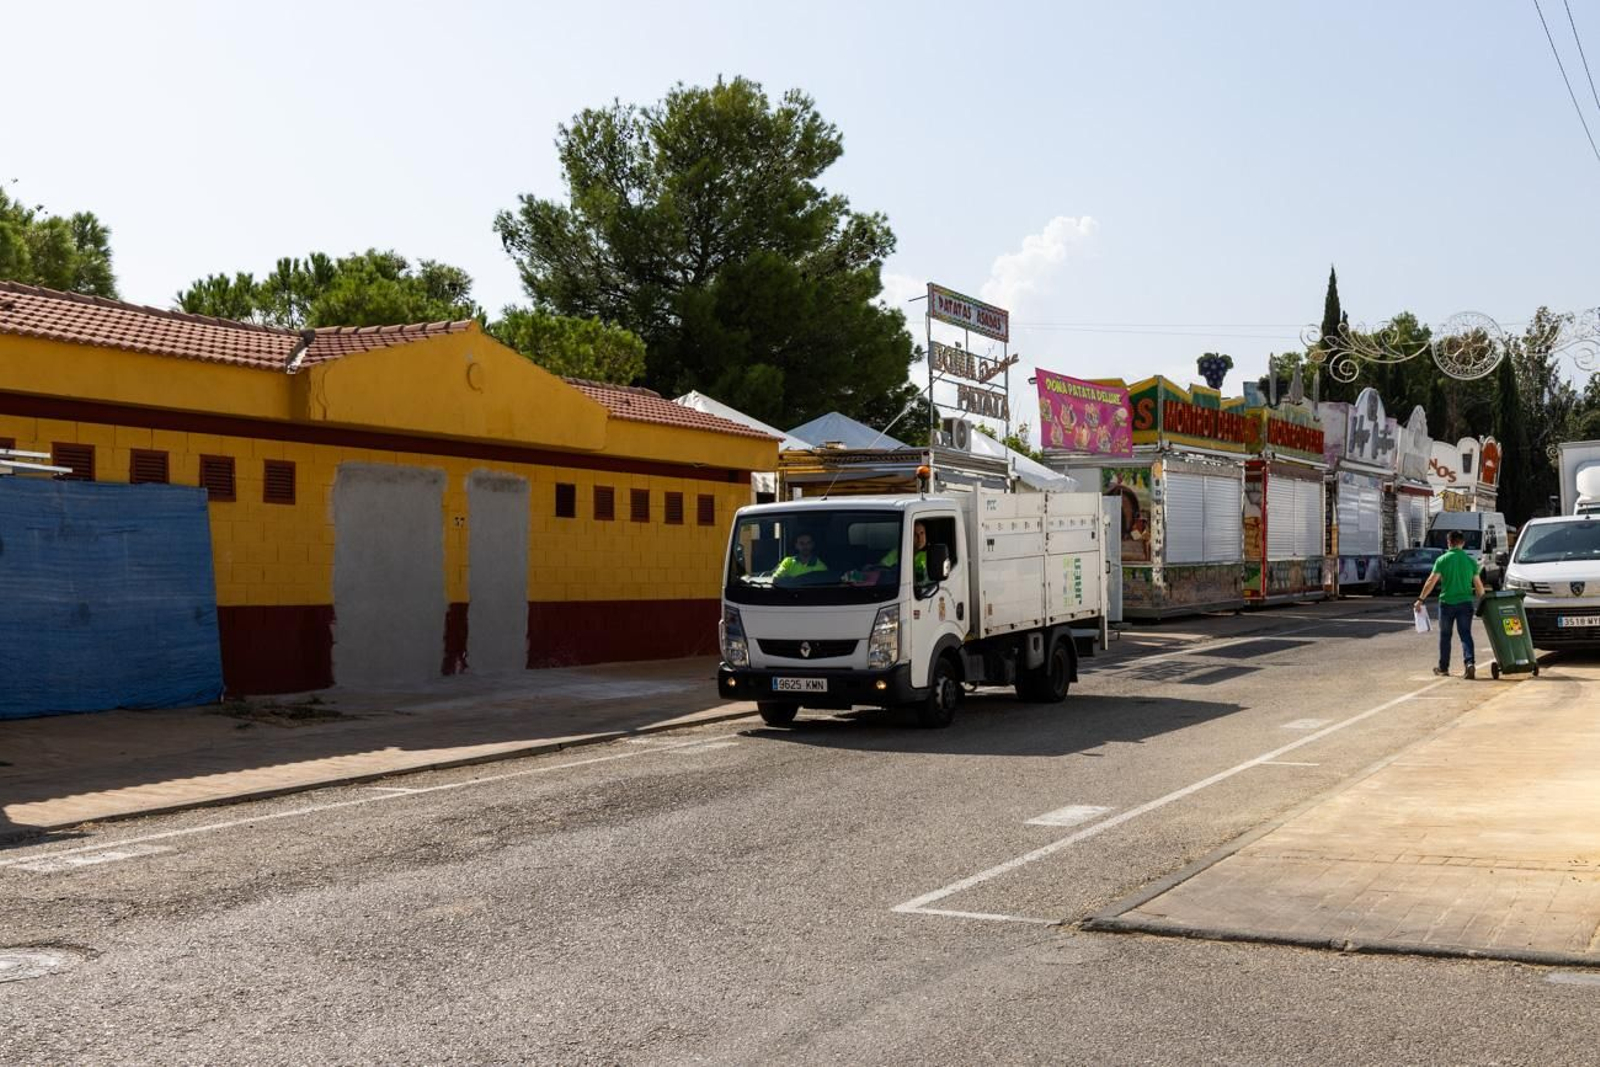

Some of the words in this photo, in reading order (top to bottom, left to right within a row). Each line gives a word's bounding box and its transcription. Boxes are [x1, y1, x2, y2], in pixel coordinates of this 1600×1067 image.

[938, 294, 971, 320] PATATAS
[1045, 375, 1067, 395] DOÑA
[1067, 383, 1096, 401] PATATA
[957, 384, 1011, 422] PATATA
[779, 678, 802, 690] 9625
